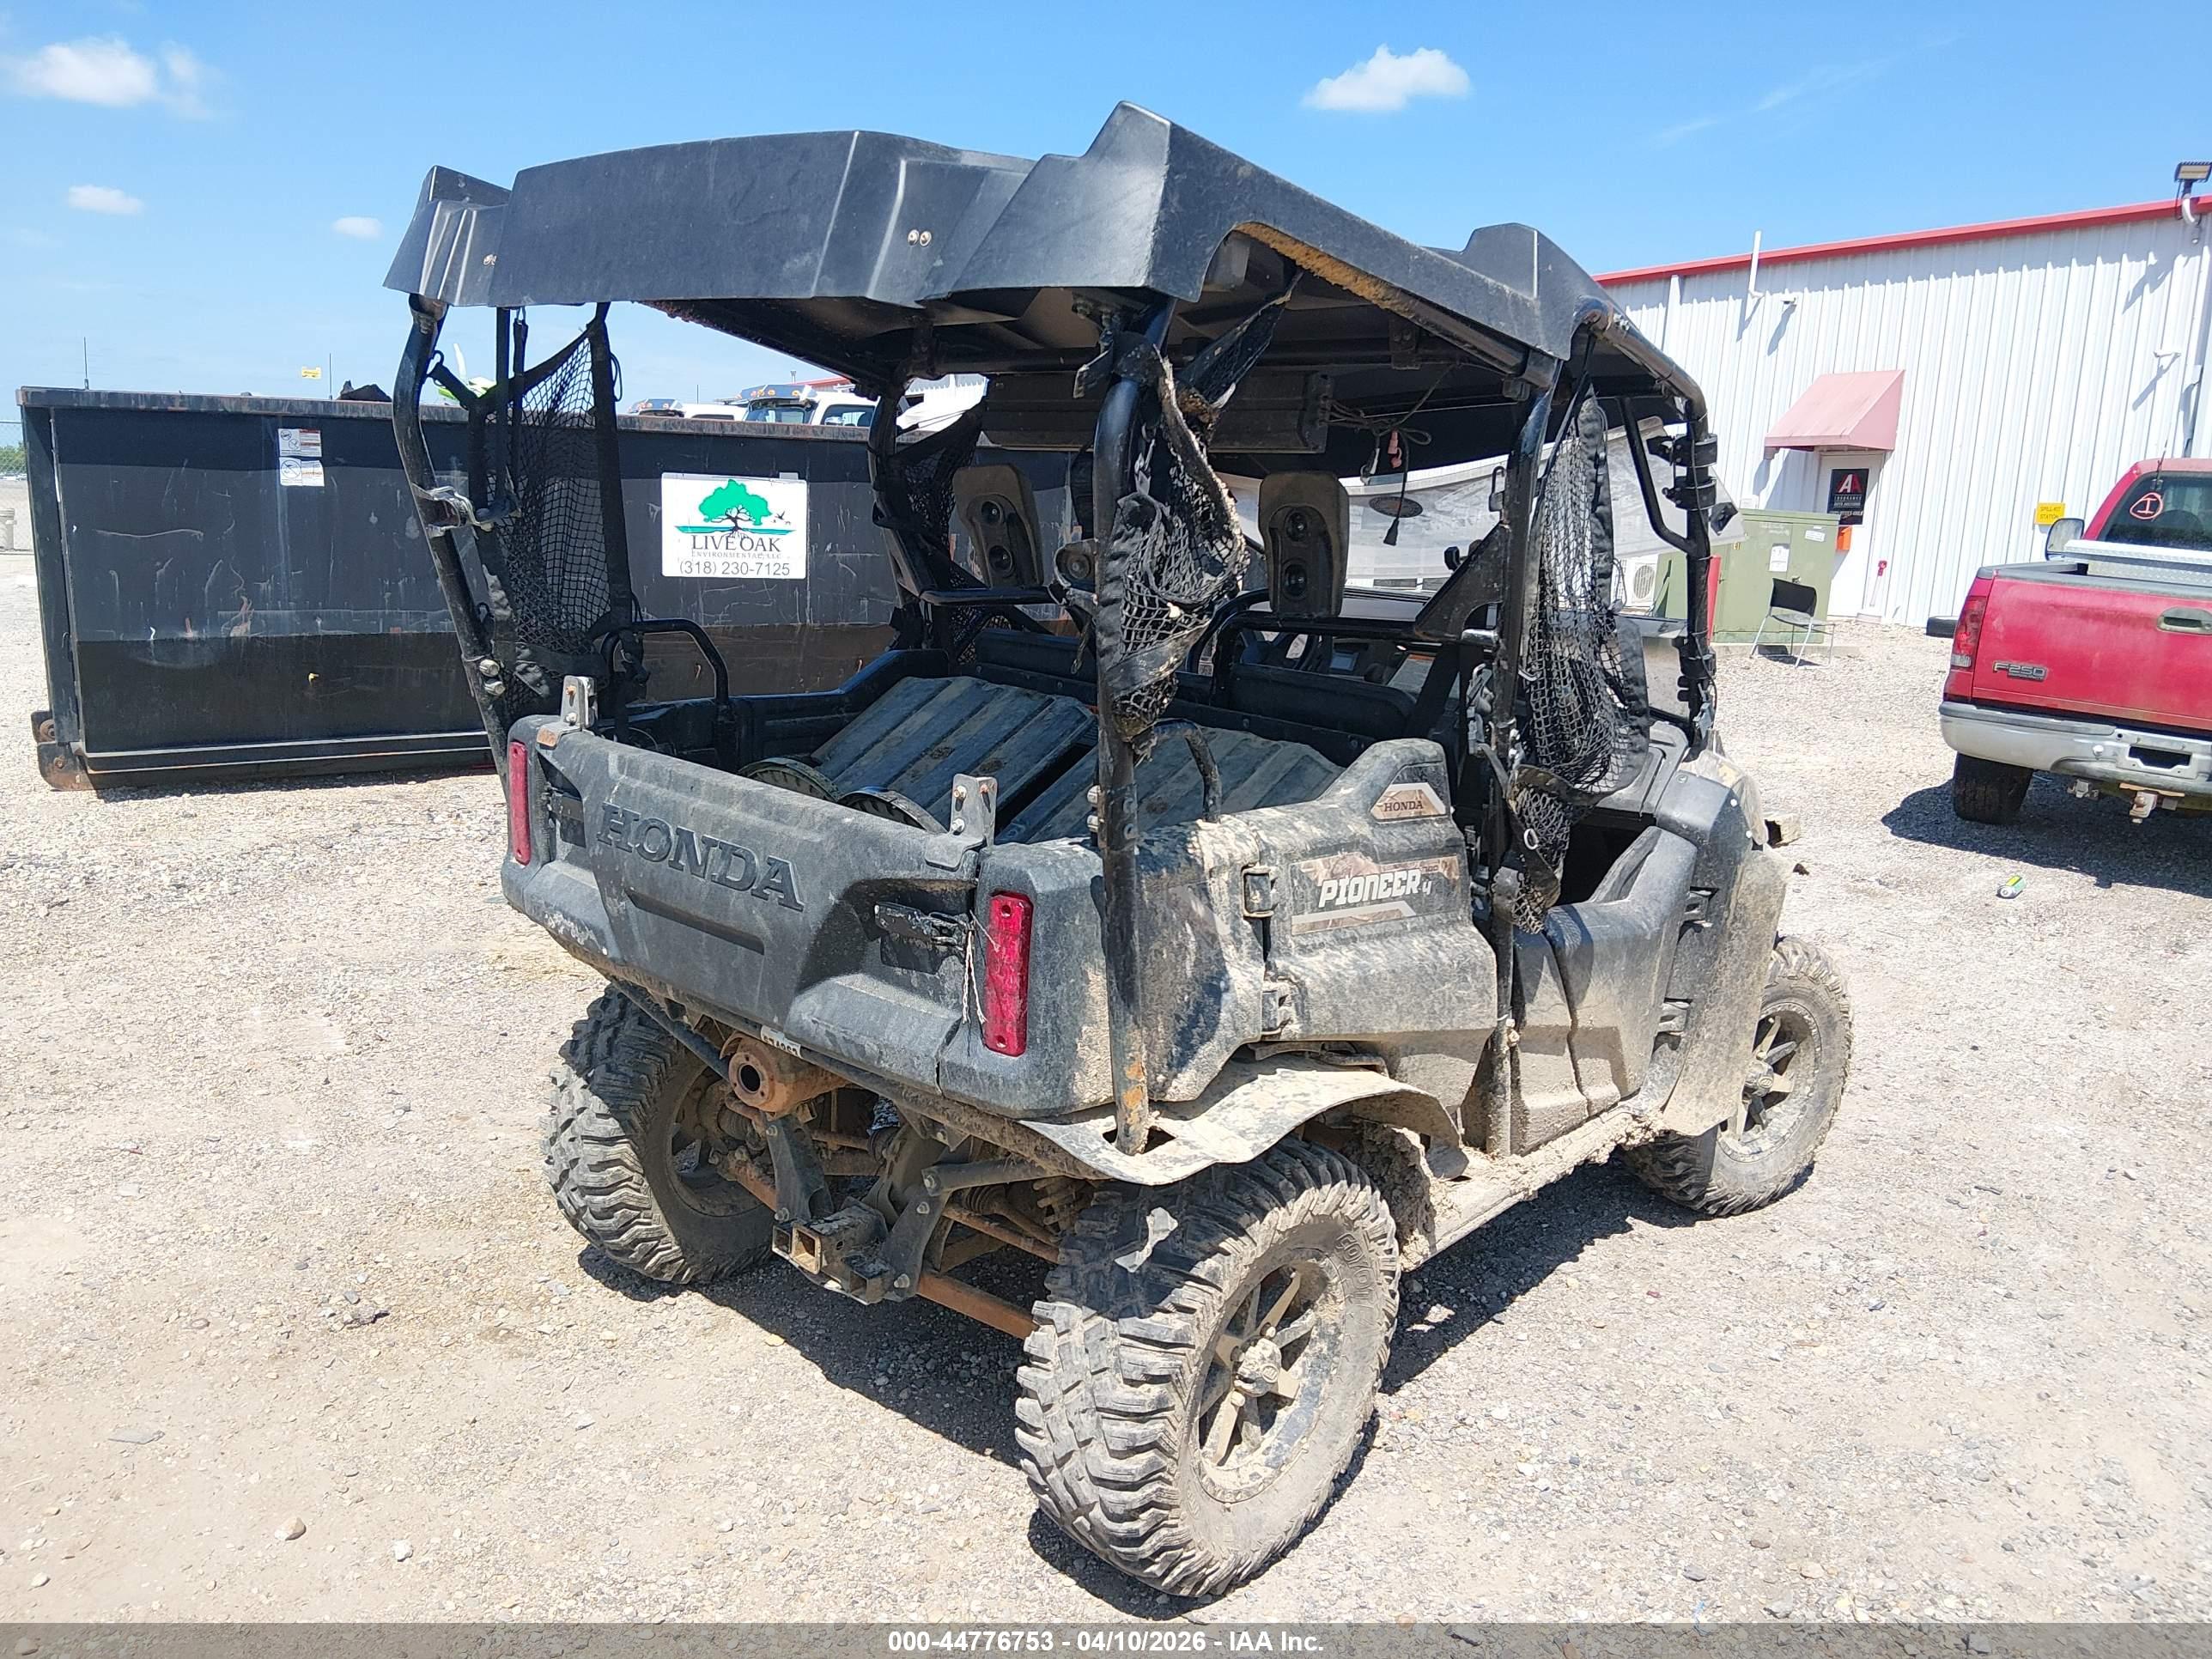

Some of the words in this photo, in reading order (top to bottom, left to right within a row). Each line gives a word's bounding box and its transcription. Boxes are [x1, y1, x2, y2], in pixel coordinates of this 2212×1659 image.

[691, 534, 737, 550] LIVE
[739, 537, 782, 552] OAK
[679, 561, 717, 575] (318)
[721, 562, 790, 576] 230-7125
[1383, 800, 1425, 812] HONDA
[597, 801, 805, 913] HONDA
[1318, 869, 1421, 908] PIONEER
